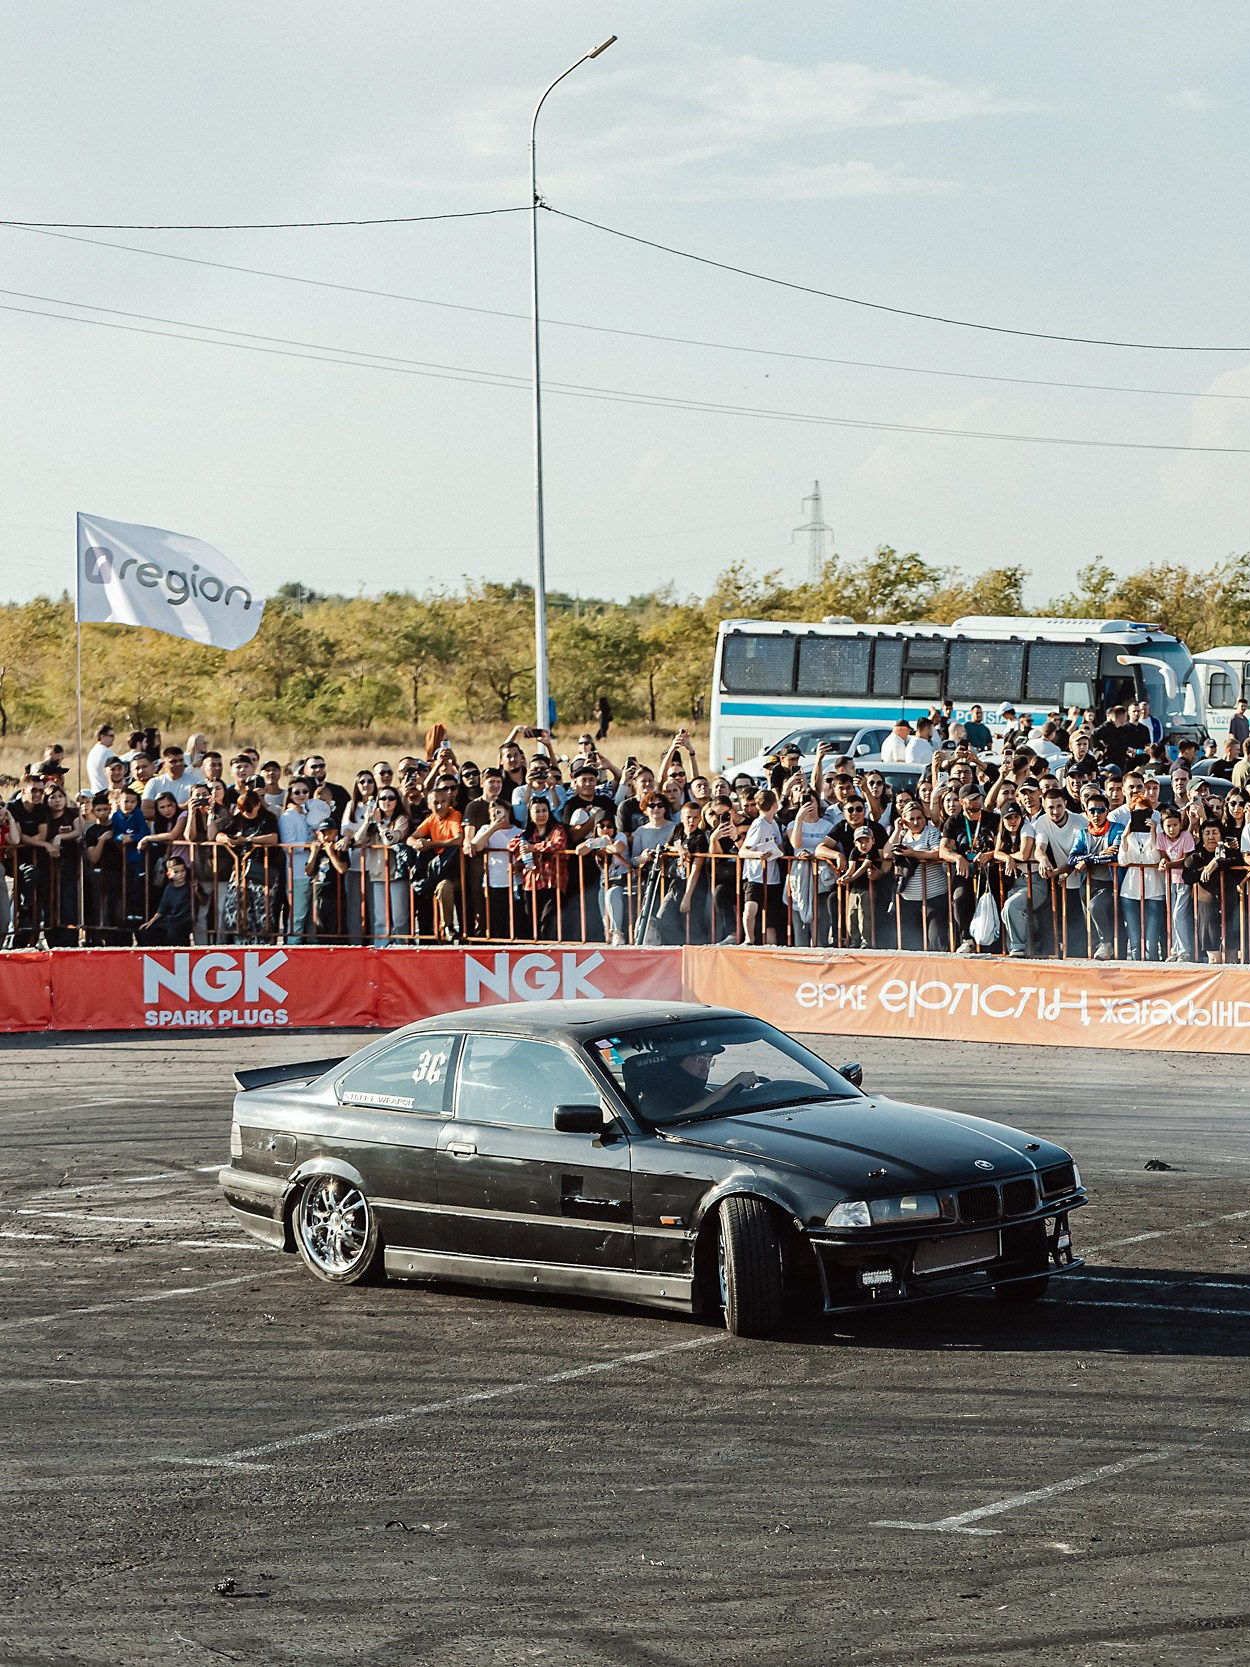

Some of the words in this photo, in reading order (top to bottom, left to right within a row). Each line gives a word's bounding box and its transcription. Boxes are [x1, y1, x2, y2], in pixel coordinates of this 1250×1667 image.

[119, 558, 252, 611] region
[143, 950, 289, 1004] NGK
[465, 952, 605, 1003] NGK
[145, 1009, 215, 1026] SPARK
[218, 1009, 289, 1026] PLUGS
[411, 1049, 447, 1086] 36
[378, 1096, 414, 1107] WEAPON
